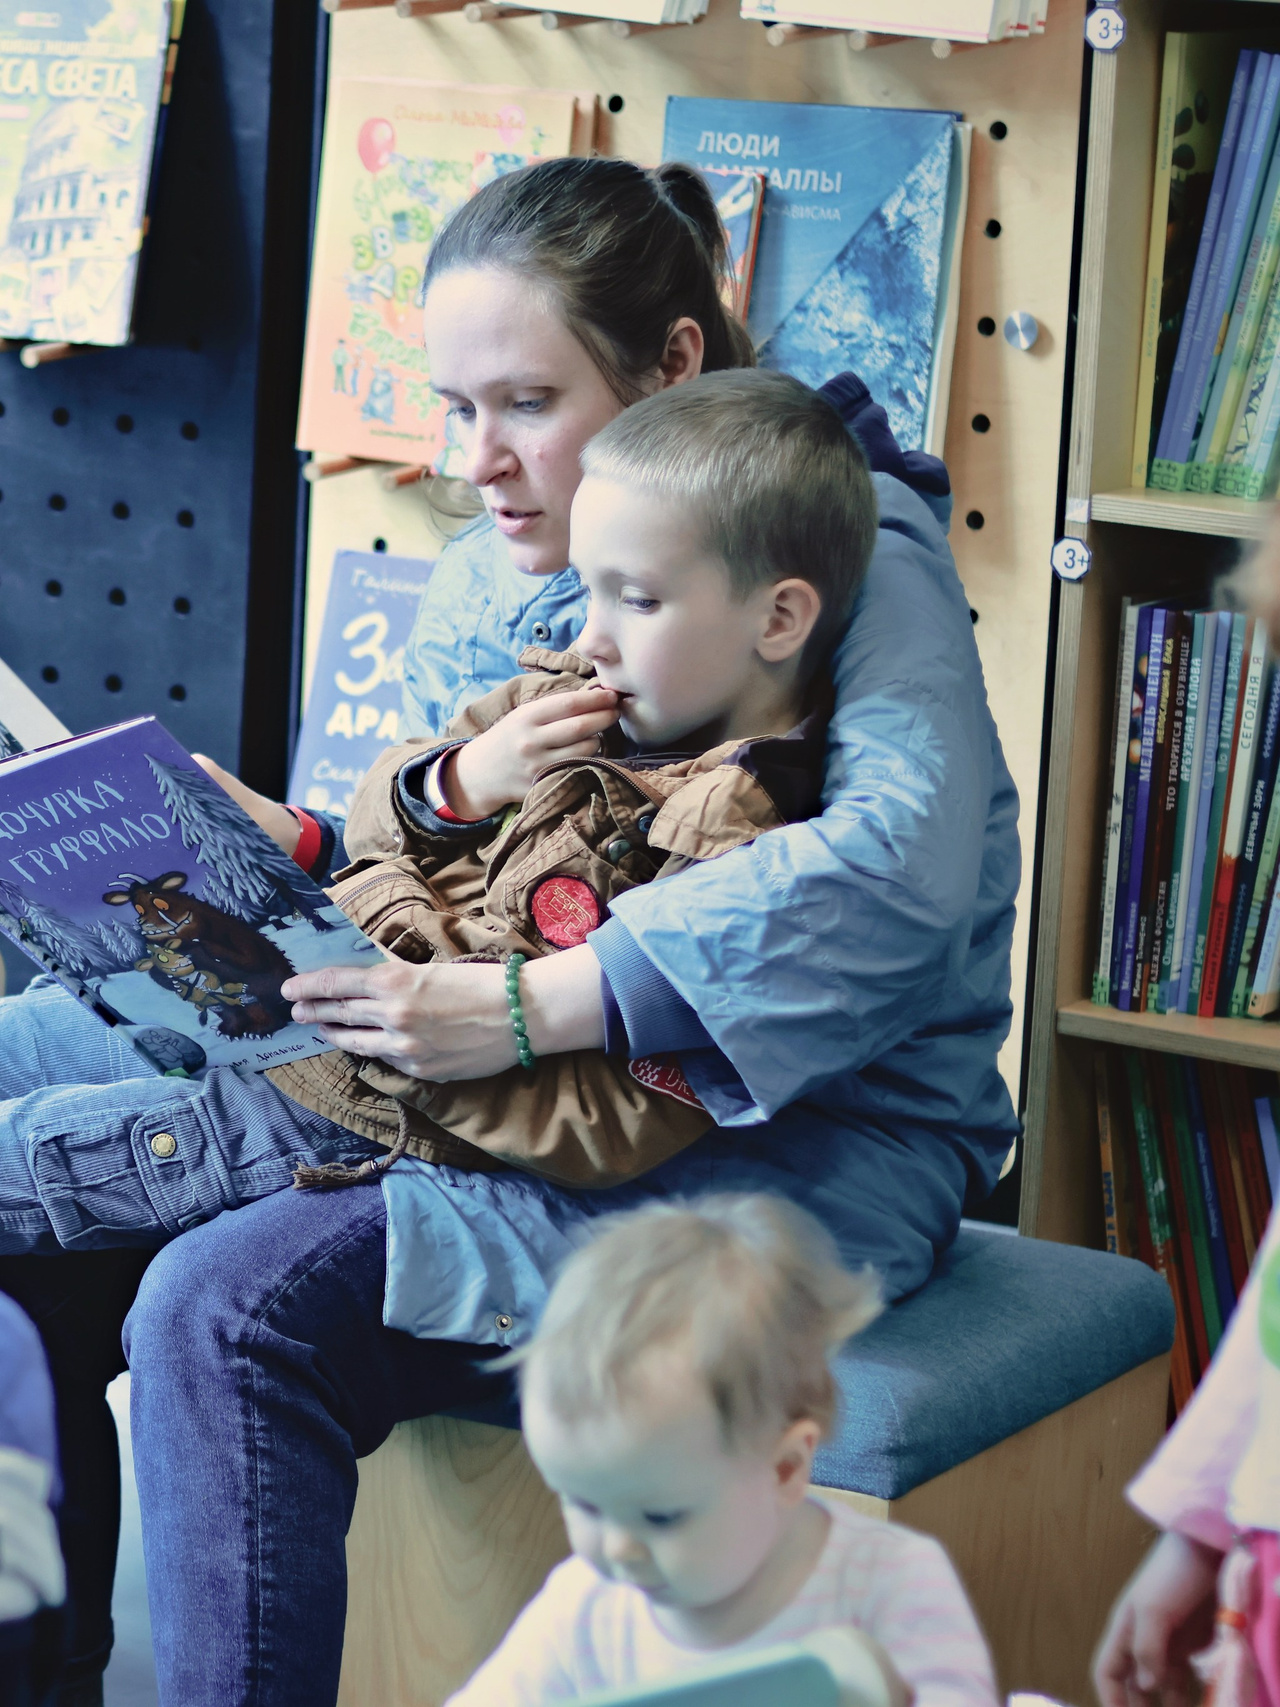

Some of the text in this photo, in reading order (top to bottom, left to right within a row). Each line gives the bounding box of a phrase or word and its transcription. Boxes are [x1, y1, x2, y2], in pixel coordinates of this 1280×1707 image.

[1099, 17, 1124, 39] 3+
[46, 59, 137, 99] СВЕТА
[697, 131, 780, 160] ЛЮДИ
[1064, 548, 1090, 569] 3+
[1146, 633, 1163, 697] НЕПТУН
[1175, 635, 1191, 706] ОБУВНИЦЕ?
[1186, 657, 1201, 709] ГОЛОВА
[325, 702, 400, 741] АРА
[1174, 709, 1183, 718] В
[1202, 654, 1224, 790] САДОВЫЕ ГНОМЫ
[1240, 675, 1260, 750] СЕГОДНЯ
[1139, 705, 1156, 782] МЕДВЕДЬ
[1168, 721, 1183, 782] ТВОРИТСЯ
[1179, 716, 1195, 782] АРБУЗНАЯ
[1166, 787, 1176, 811] ЧТО
[1245, 780, 1266, 861] ДЕВИЧЬИ ЗОРИ
[9, 813, 171, 884] ГРУФФАЛО
[1150, 940, 1161, 982] АДЕЖДА
[255, 1044, 306, 1063] Дональдсон
